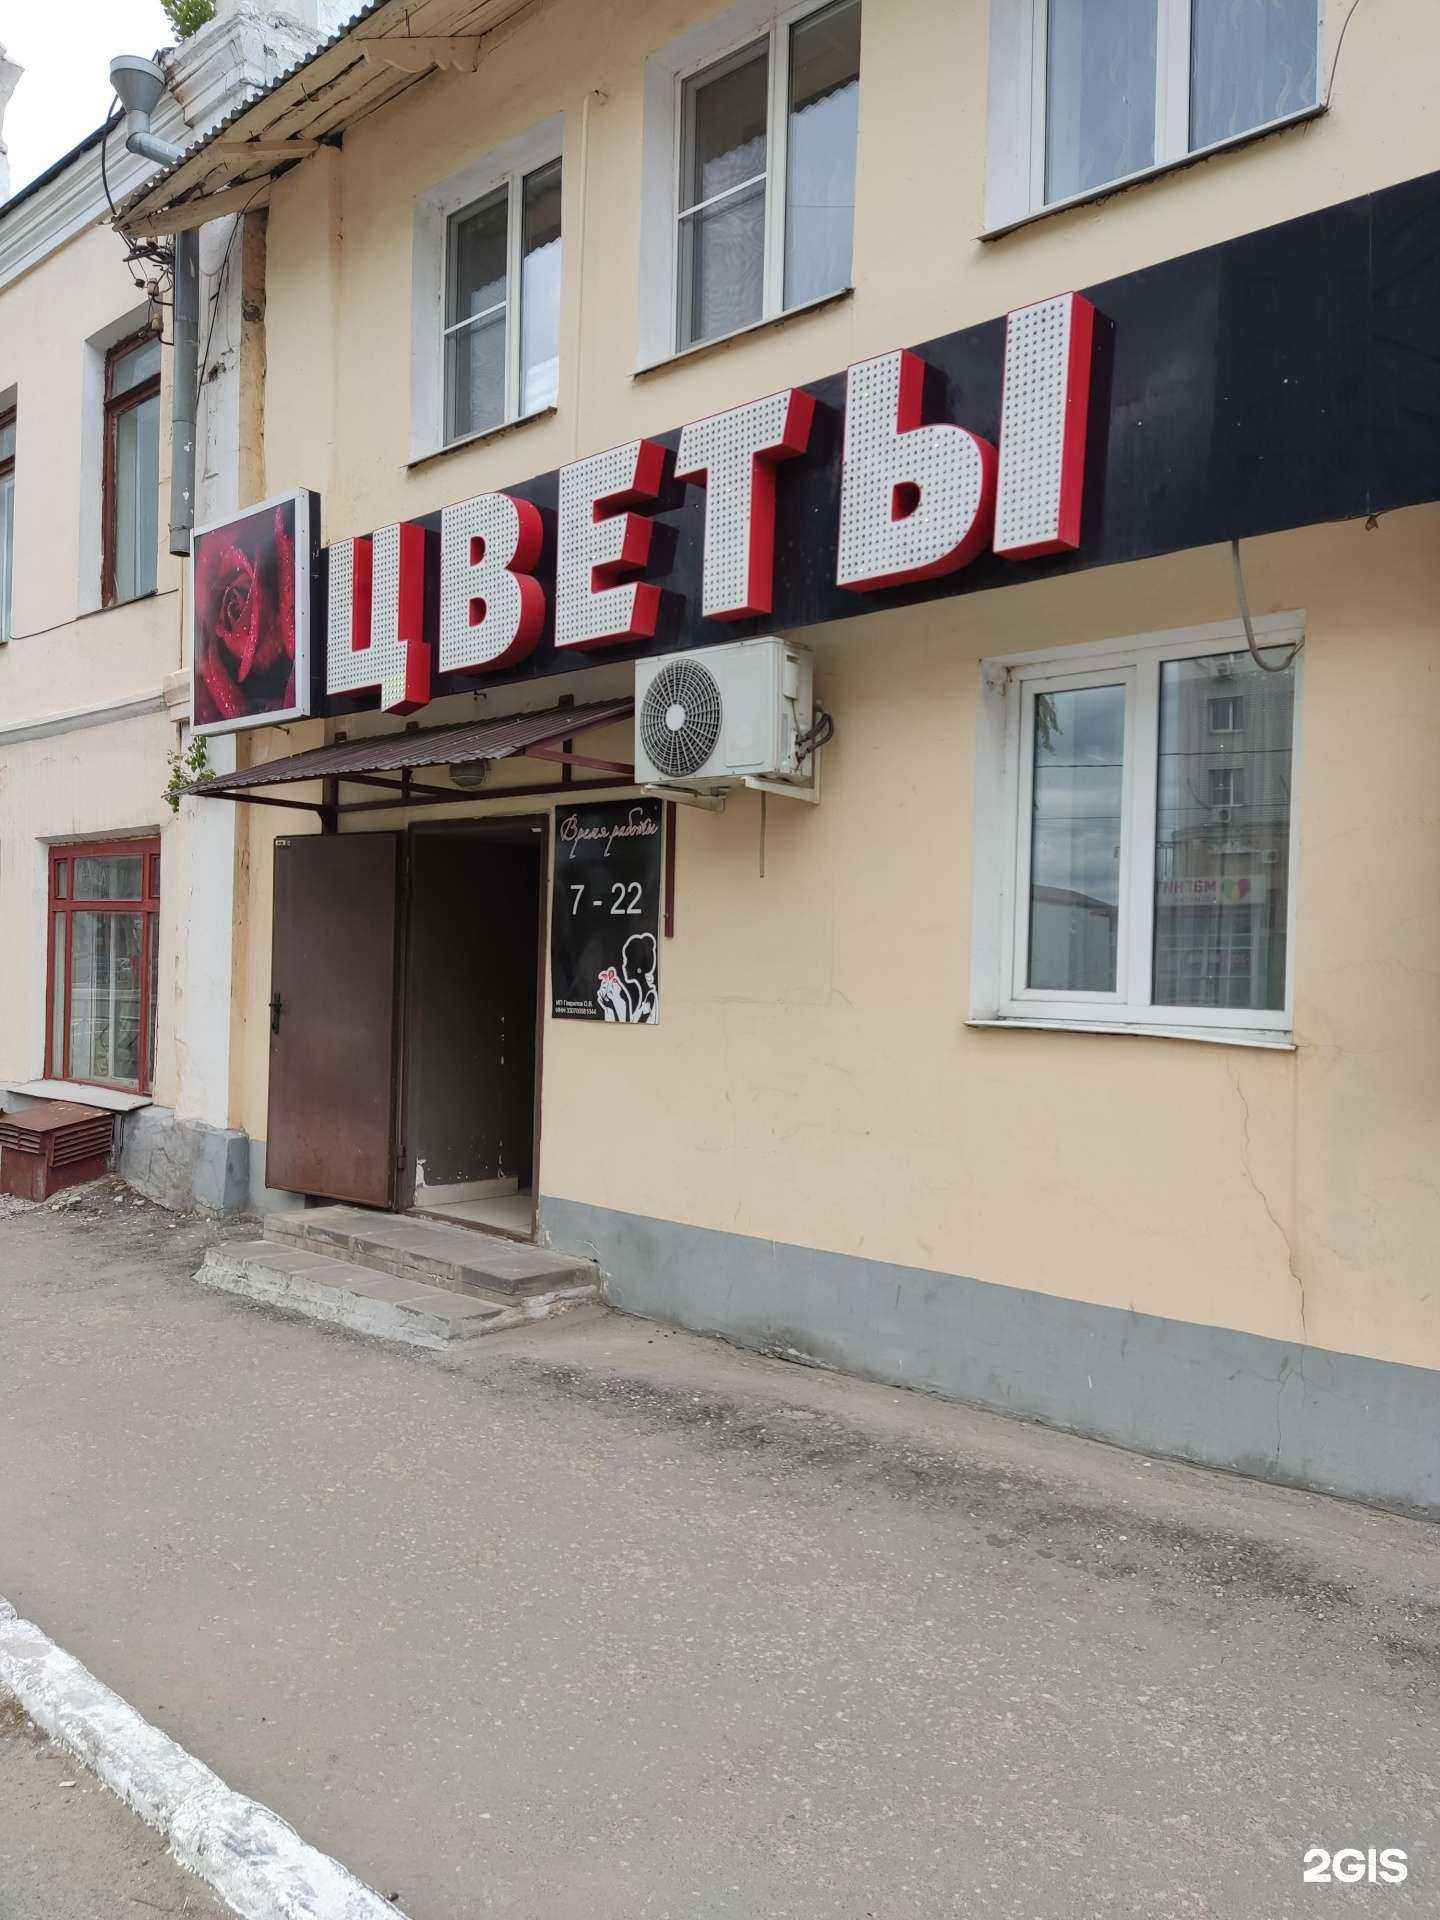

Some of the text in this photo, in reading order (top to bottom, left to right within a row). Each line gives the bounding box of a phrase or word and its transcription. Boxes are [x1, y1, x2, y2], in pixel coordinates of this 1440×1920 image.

[326, 291, 1094, 716] ЦВЕТЫ
[560, 806, 659, 859] Время работы
[570, 884, 585, 915] 7
[610, 881, 642, 915] 22
